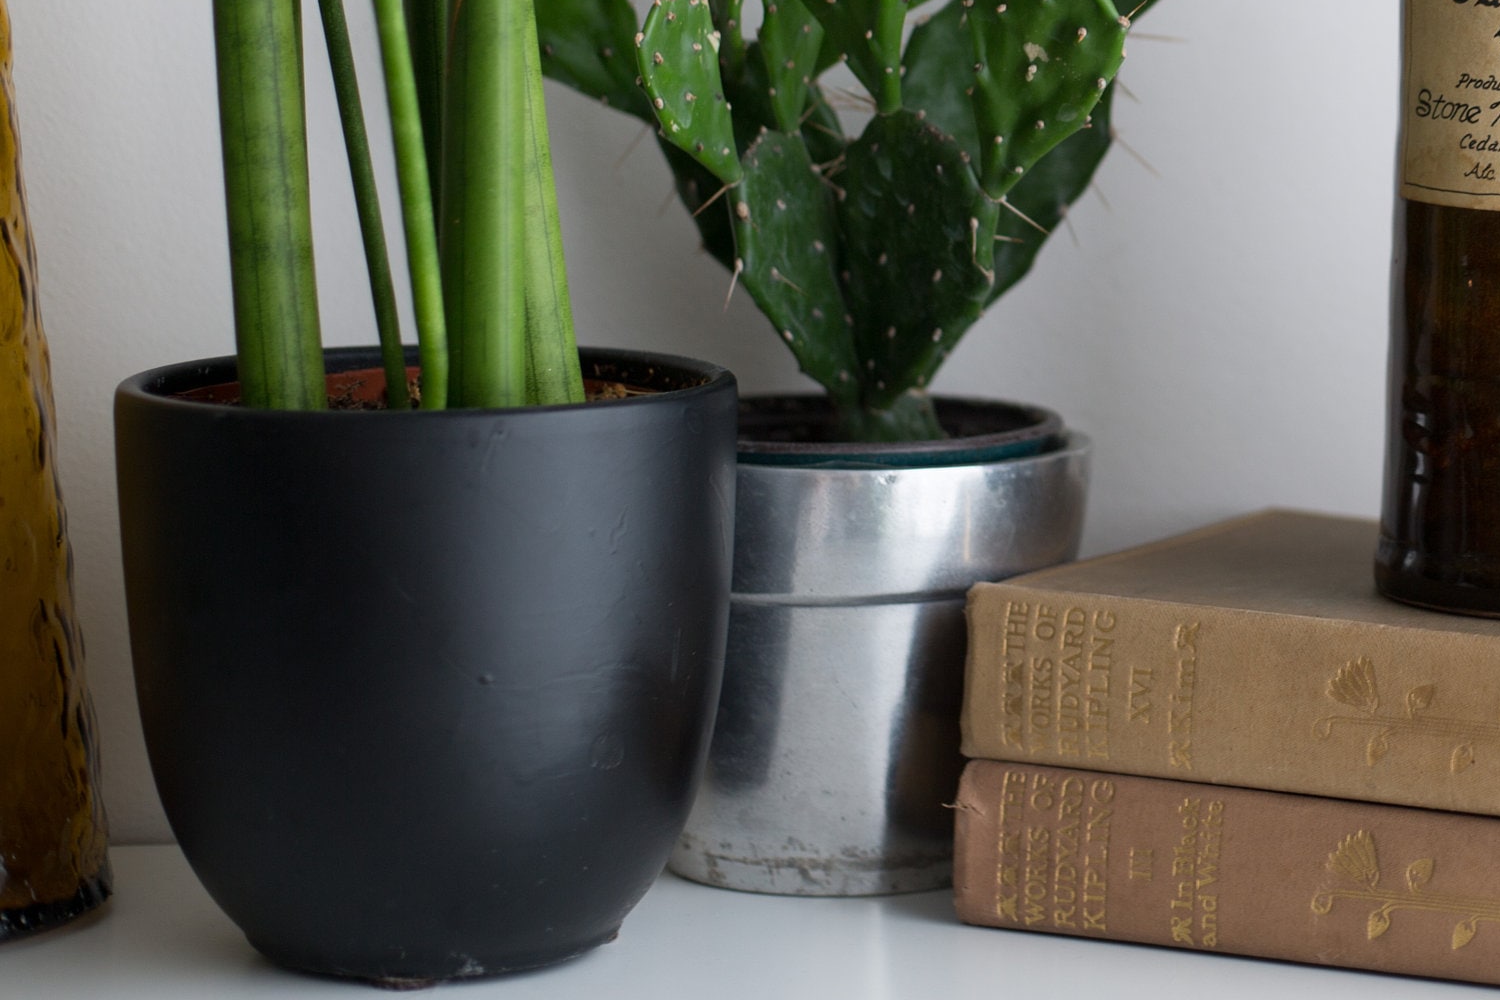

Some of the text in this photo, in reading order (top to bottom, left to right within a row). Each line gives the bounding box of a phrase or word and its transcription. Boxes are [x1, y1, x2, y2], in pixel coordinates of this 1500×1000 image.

[1415, 89, 1482, 124] Stone
[1002, 601, 1030, 656] THE
[1027, 603, 1058, 756] WORKS OF
[1056, 606, 1087, 757] RUDYARD
[1085, 608, 1118, 760] KIPLING
[998, 770, 1027, 825] THE
[1024, 773, 1056, 926] WORKS OF
[1053, 775, 1085, 929] RUDYARD
[1082, 778, 1116, 932] KIPLING
[1171, 797, 1201, 878] Black
[1195, 800, 1225, 948] and White
